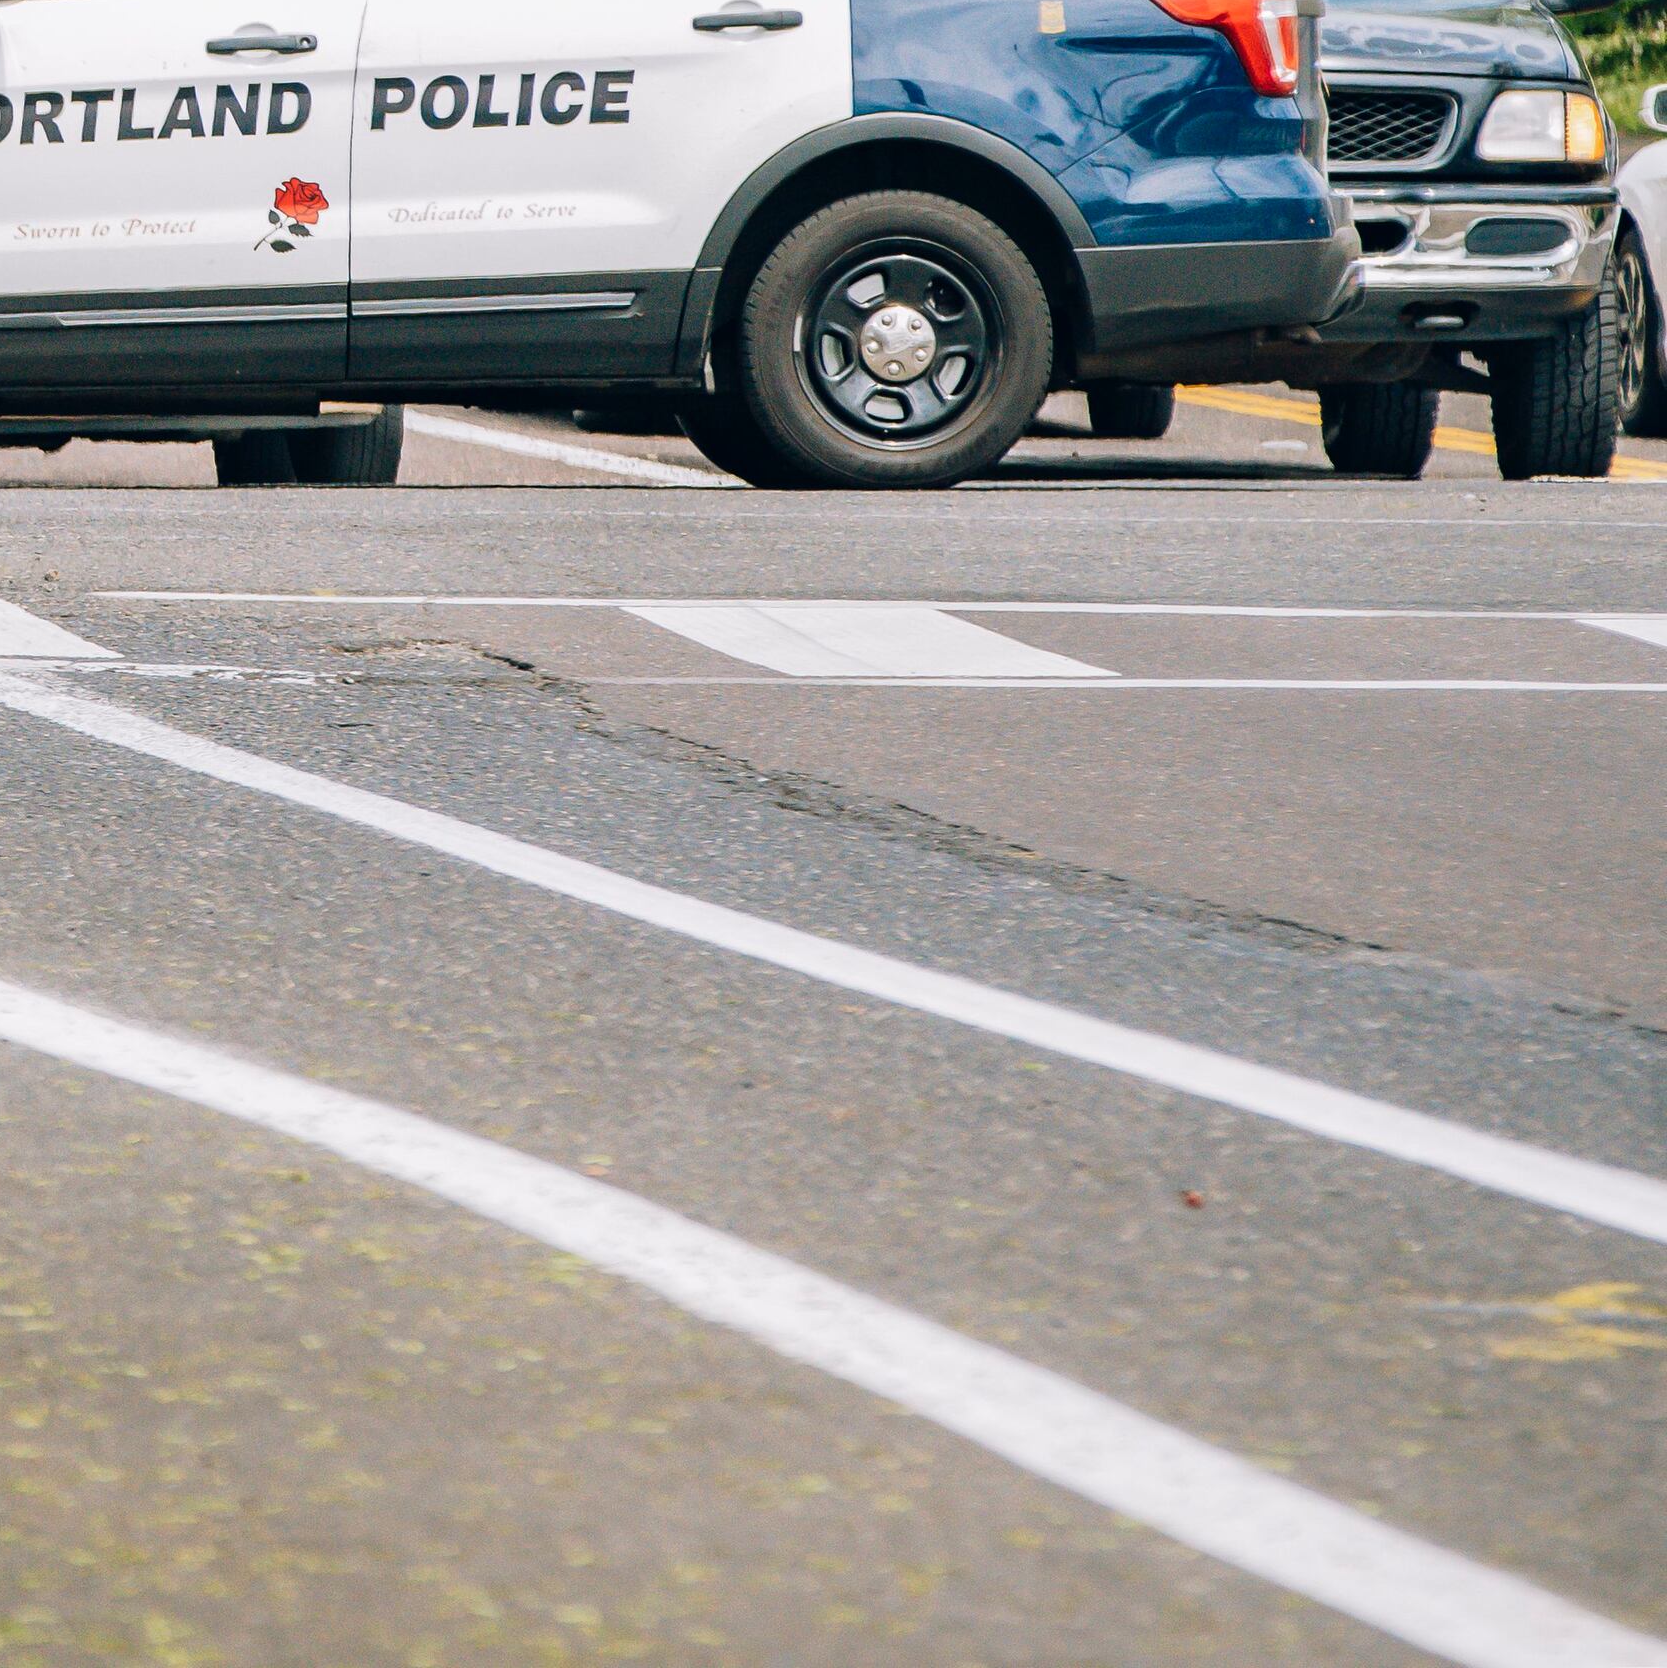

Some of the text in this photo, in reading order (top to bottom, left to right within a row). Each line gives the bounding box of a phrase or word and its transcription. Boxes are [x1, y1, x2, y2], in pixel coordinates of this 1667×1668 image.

[370, 70, 635, 130] POLICE
[387, 199, 577, 223] Dedicated to Serve
[13, 218, 197, 240] Sworn to Protect
